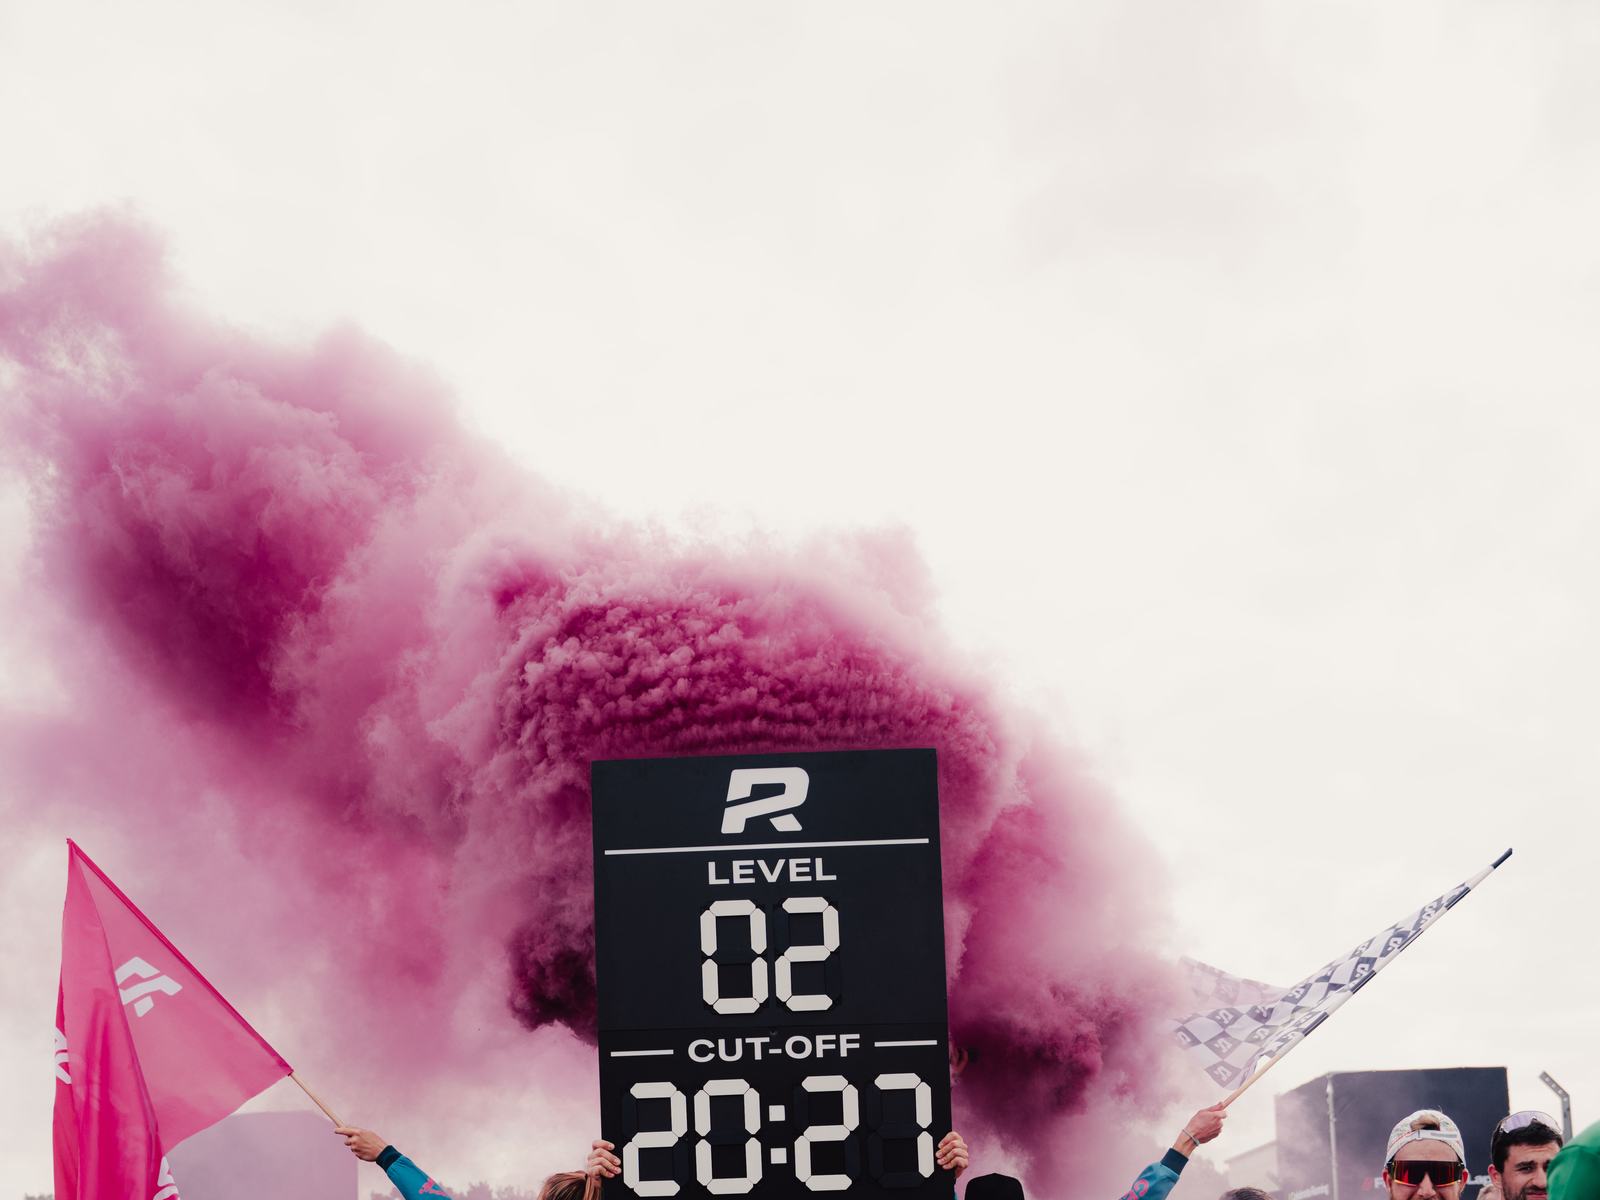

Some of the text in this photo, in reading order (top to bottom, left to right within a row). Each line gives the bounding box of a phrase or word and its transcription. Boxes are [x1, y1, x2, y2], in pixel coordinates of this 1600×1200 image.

[720, 766, 810, 834] R
[707, 856, 837, 885] LEVEL
[699, 896, 841, 1015] 02
[687, 1033, 861, 1063] CUT-OFF
[622, 1072, 935, 1198] 20:27
